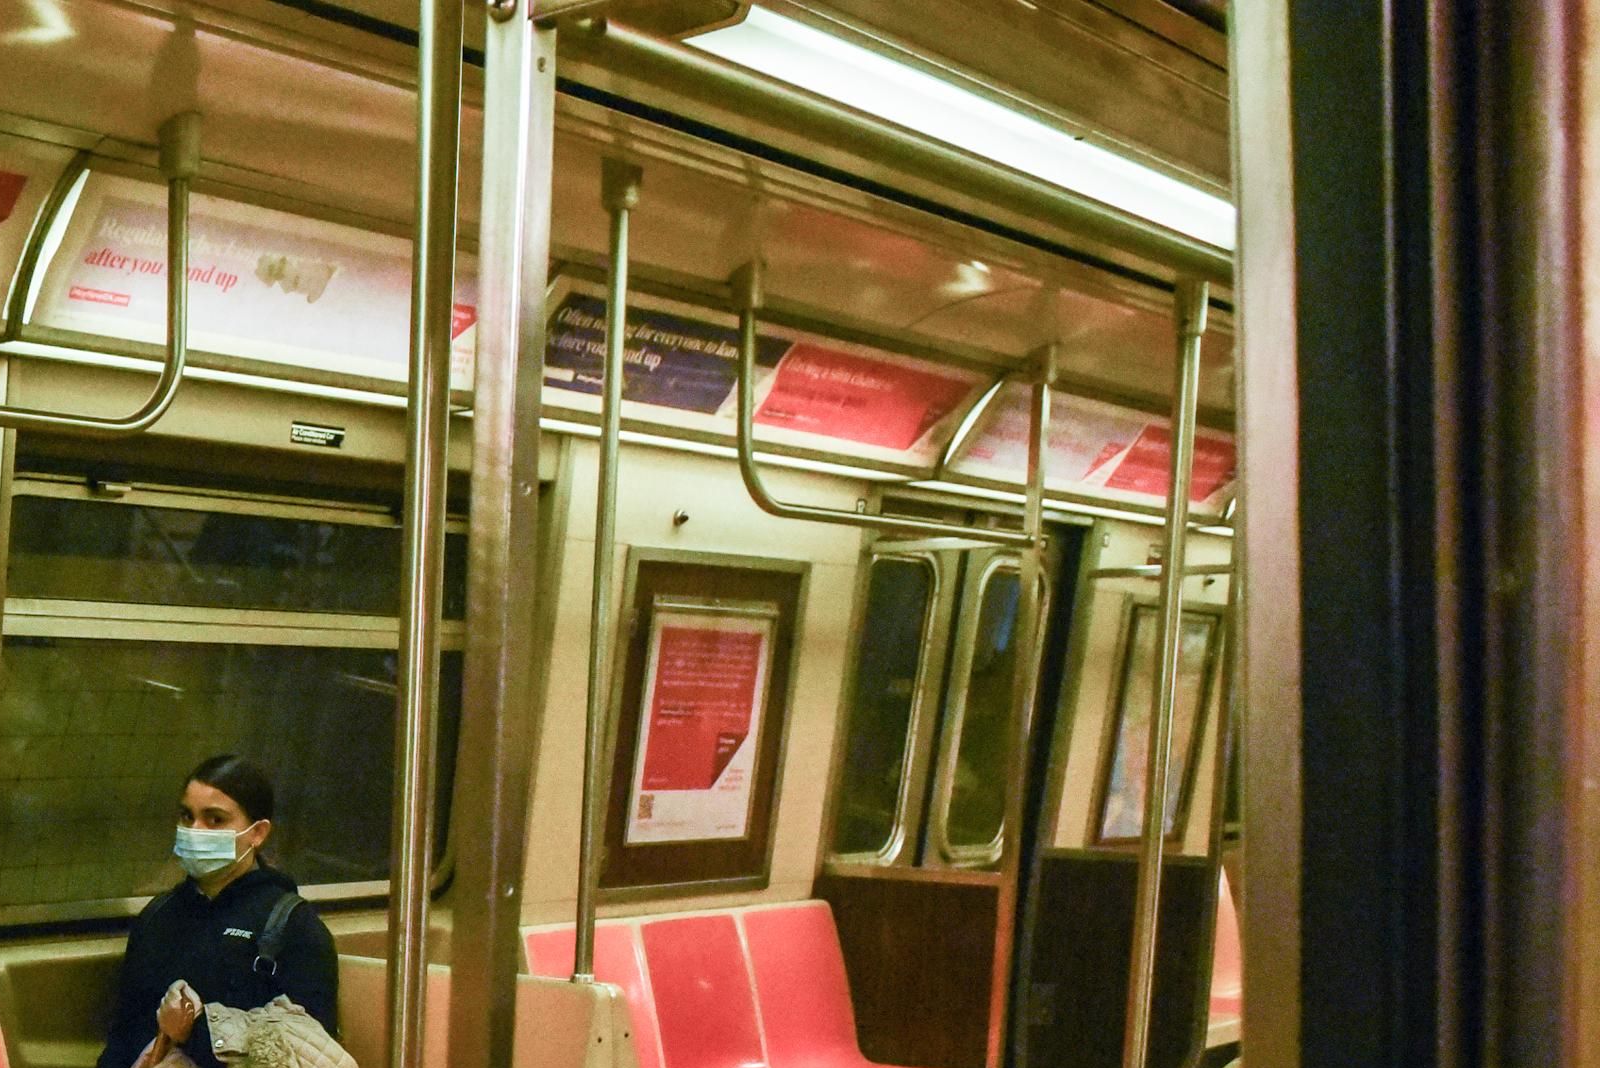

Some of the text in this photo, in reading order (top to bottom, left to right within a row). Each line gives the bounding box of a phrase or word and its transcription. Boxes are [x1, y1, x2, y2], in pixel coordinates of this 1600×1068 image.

[84, 247, 129, 269] after
[127, 258, 164, 276] you
[215, 271, 239, 293] up
